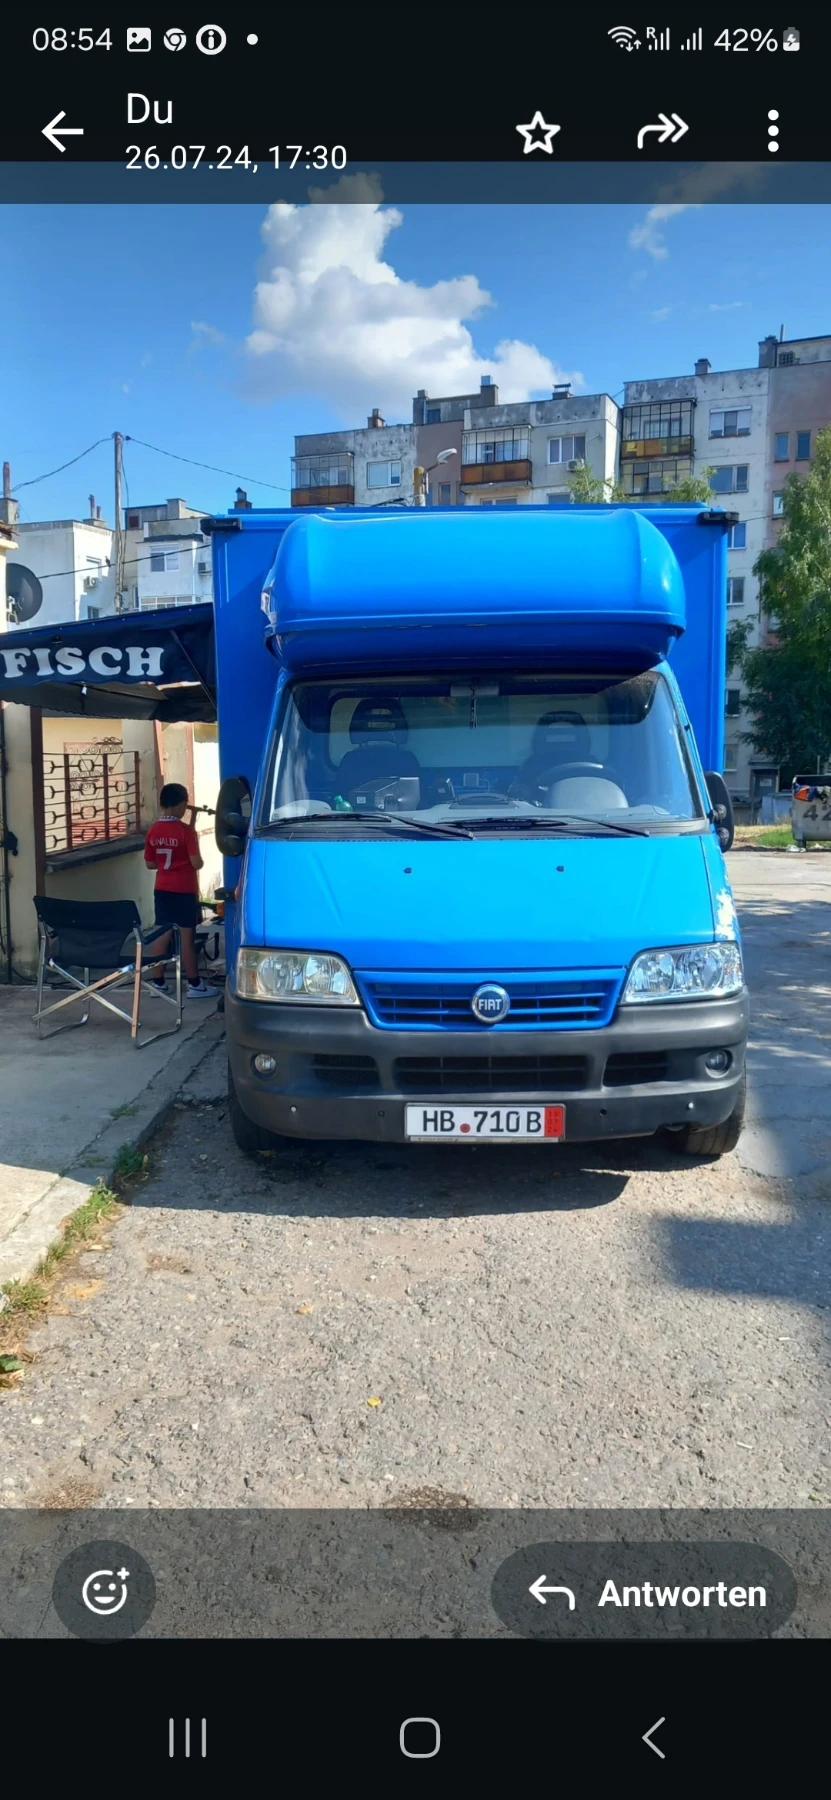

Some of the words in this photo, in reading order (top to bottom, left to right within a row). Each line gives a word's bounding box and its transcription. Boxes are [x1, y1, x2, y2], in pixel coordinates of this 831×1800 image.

[2, 646, 165, 678] FISCH
[155, 848, 173, 870] 7
[478, 998, 502, 1011] FIAT
[422, 1109, 456, 1132] HB
[473, 1110, 520, 1132] 710
[526, 1111, 542, 1133] B
